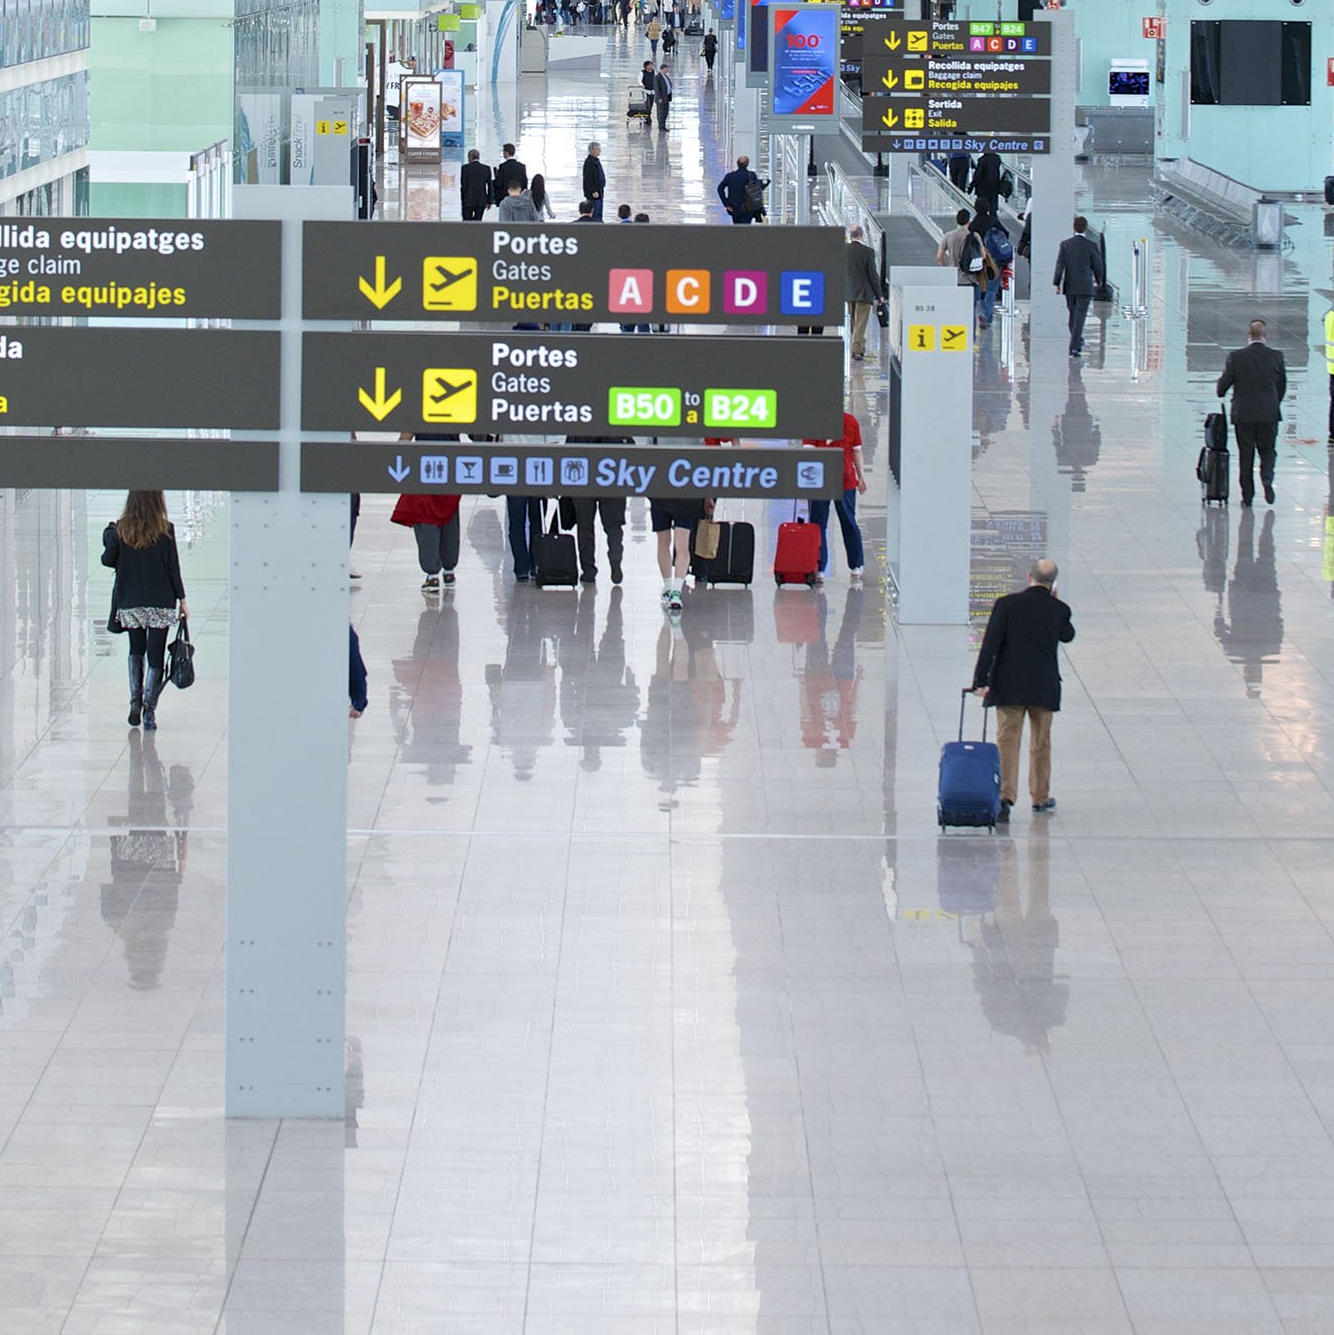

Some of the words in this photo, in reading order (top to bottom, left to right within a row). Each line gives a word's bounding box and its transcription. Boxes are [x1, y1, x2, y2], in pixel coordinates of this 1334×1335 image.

[933, 22, 959, 30] Portes
[973, 25, 991, 33] B47
[1004, 25, 1021, 33] B24
[974, 40, 981, 48] A
[991, 40, 998, 49] C
[1008, 40, 1016, 49] D
[1026, 40, 1032, 49] E
[847, 65, 860, 73] Sky
[929, 61, 971, 69] Recollida
[974, 62, 1024, 72] equipatges
[929, 71, 960, 81] Baggage
[929, 80, 971, 90] Recogida
[974, 81, 1018, 90] equipajes
[929, 100, 962, 108] Sortida
[929, 119, 956, 127] Salida
[965, 140, 985, 152] Sky
[990, 140, 1028, 150] Centre
[61, 227, 204, 253] equipatges
[494, 231, 578, 254] Portes
[28, 255, 80, 274] claim
[493, 260, 551, 280] Gates
[62, 282, 185, 309] equipajes
[493, 287, 593, 309] Puertas
[620, 279, 642, 305] A
[677, 277, 699, 306] C
[735, 278, 757, 306] D
[793, 279, 811, 307] E
[493, 343, 577, 367] Portes
[492, 372, 550, 393] Gates
[492, 399, 592, 422] Puertas
[616, 395, 674, 419] B50
[685, 392, 700, 405] to
[712, 395, 768, 420] B24
[687, 411, 697, 423] a
[596, 458, 655, 493] Sky
[669, 460, 777, 488] Centre
